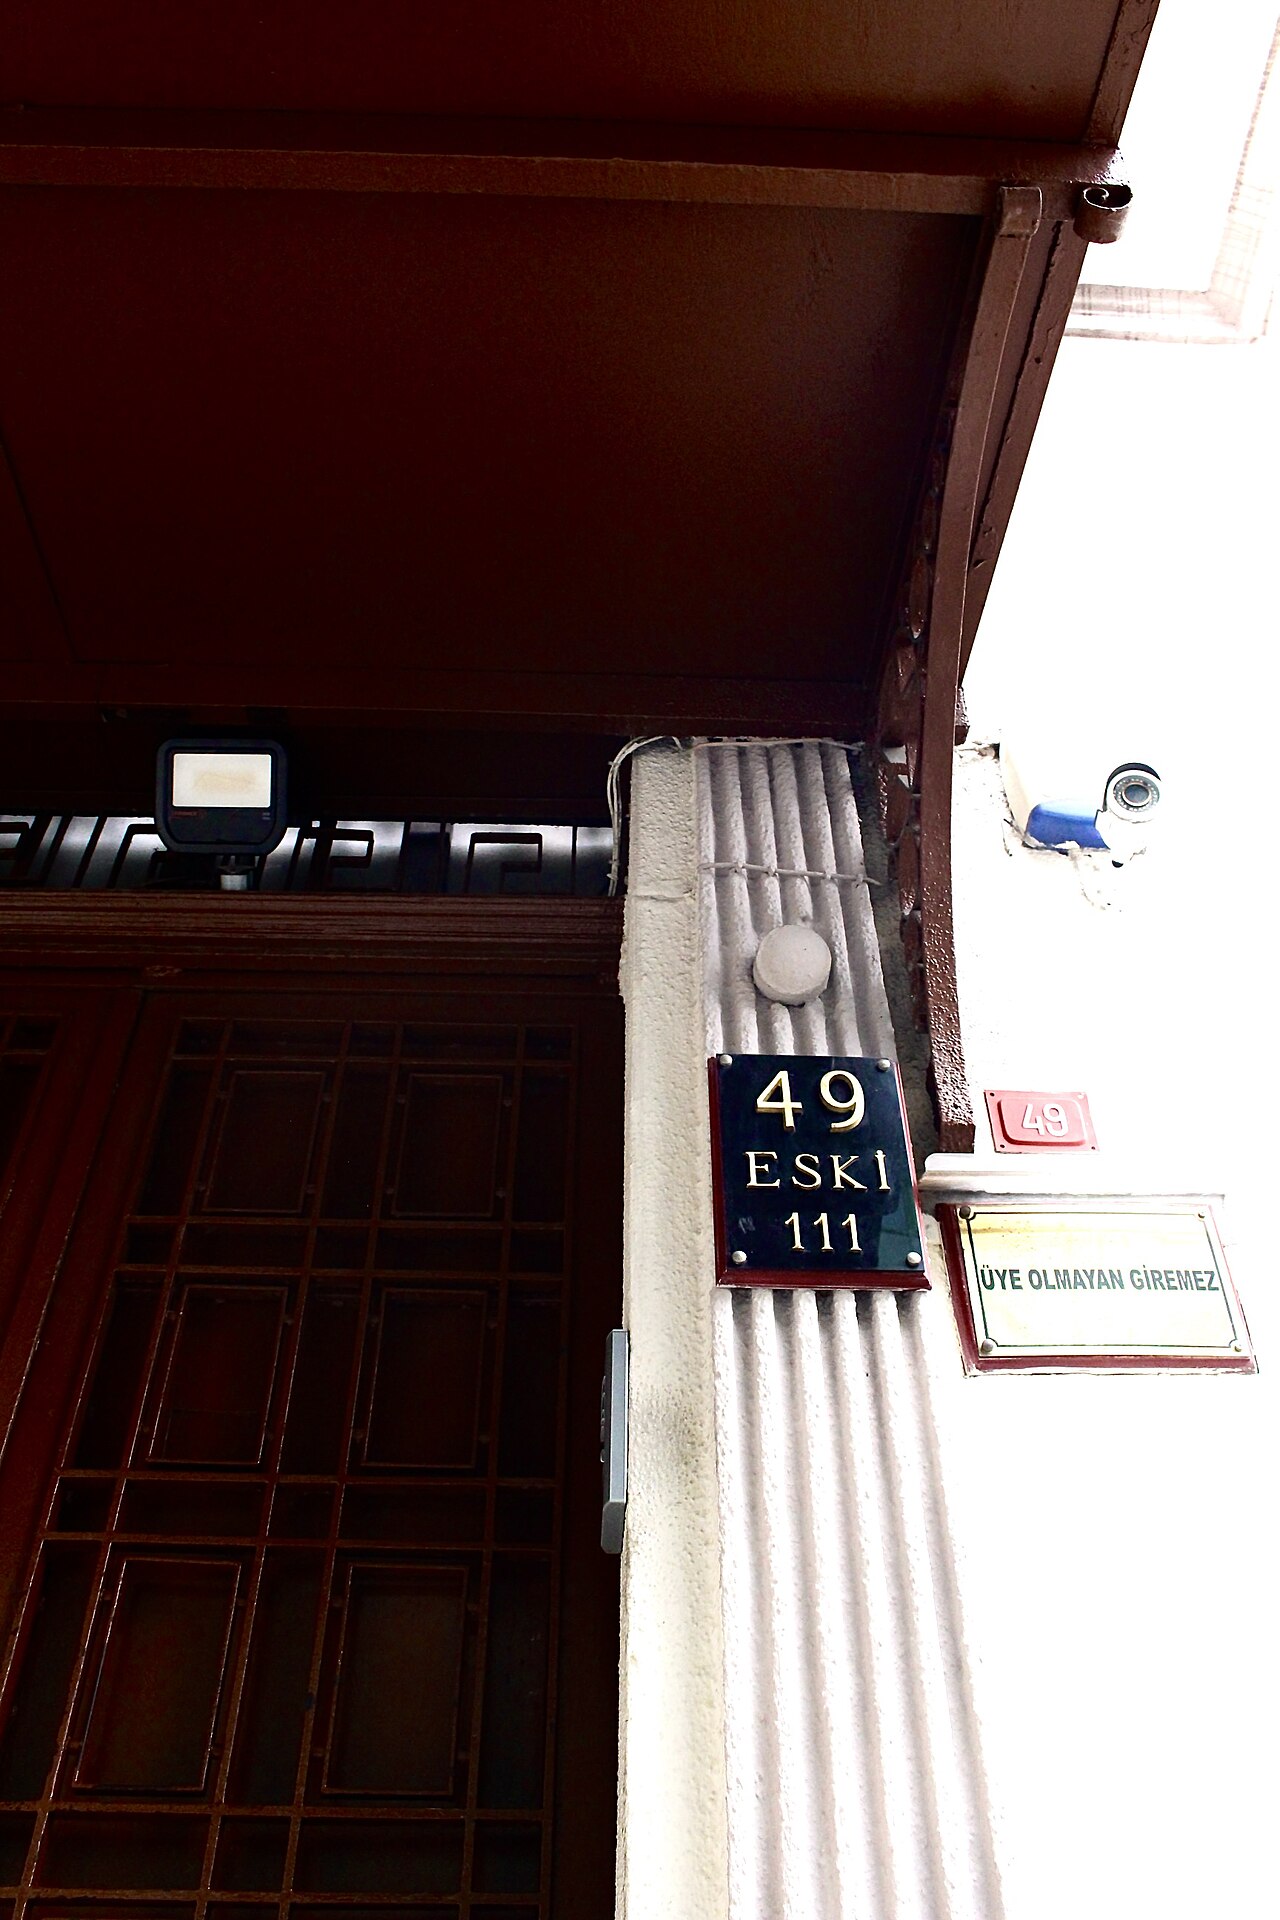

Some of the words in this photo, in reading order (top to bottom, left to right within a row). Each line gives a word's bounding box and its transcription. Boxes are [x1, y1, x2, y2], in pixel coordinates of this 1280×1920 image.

[756, 1070, 865, 1132] 49
[1022, 1103, 1068, 1137] 49
[745, 1150, 891, 1191] ESKİ
[784, 1212, 863, 1252] 111
[980, 1265, 1023, 1290] ÜYE
[1028, 1269, 1124, 1290] OLMAYAN
[1129, 1265, 1219, 1291] GİREMEZ
